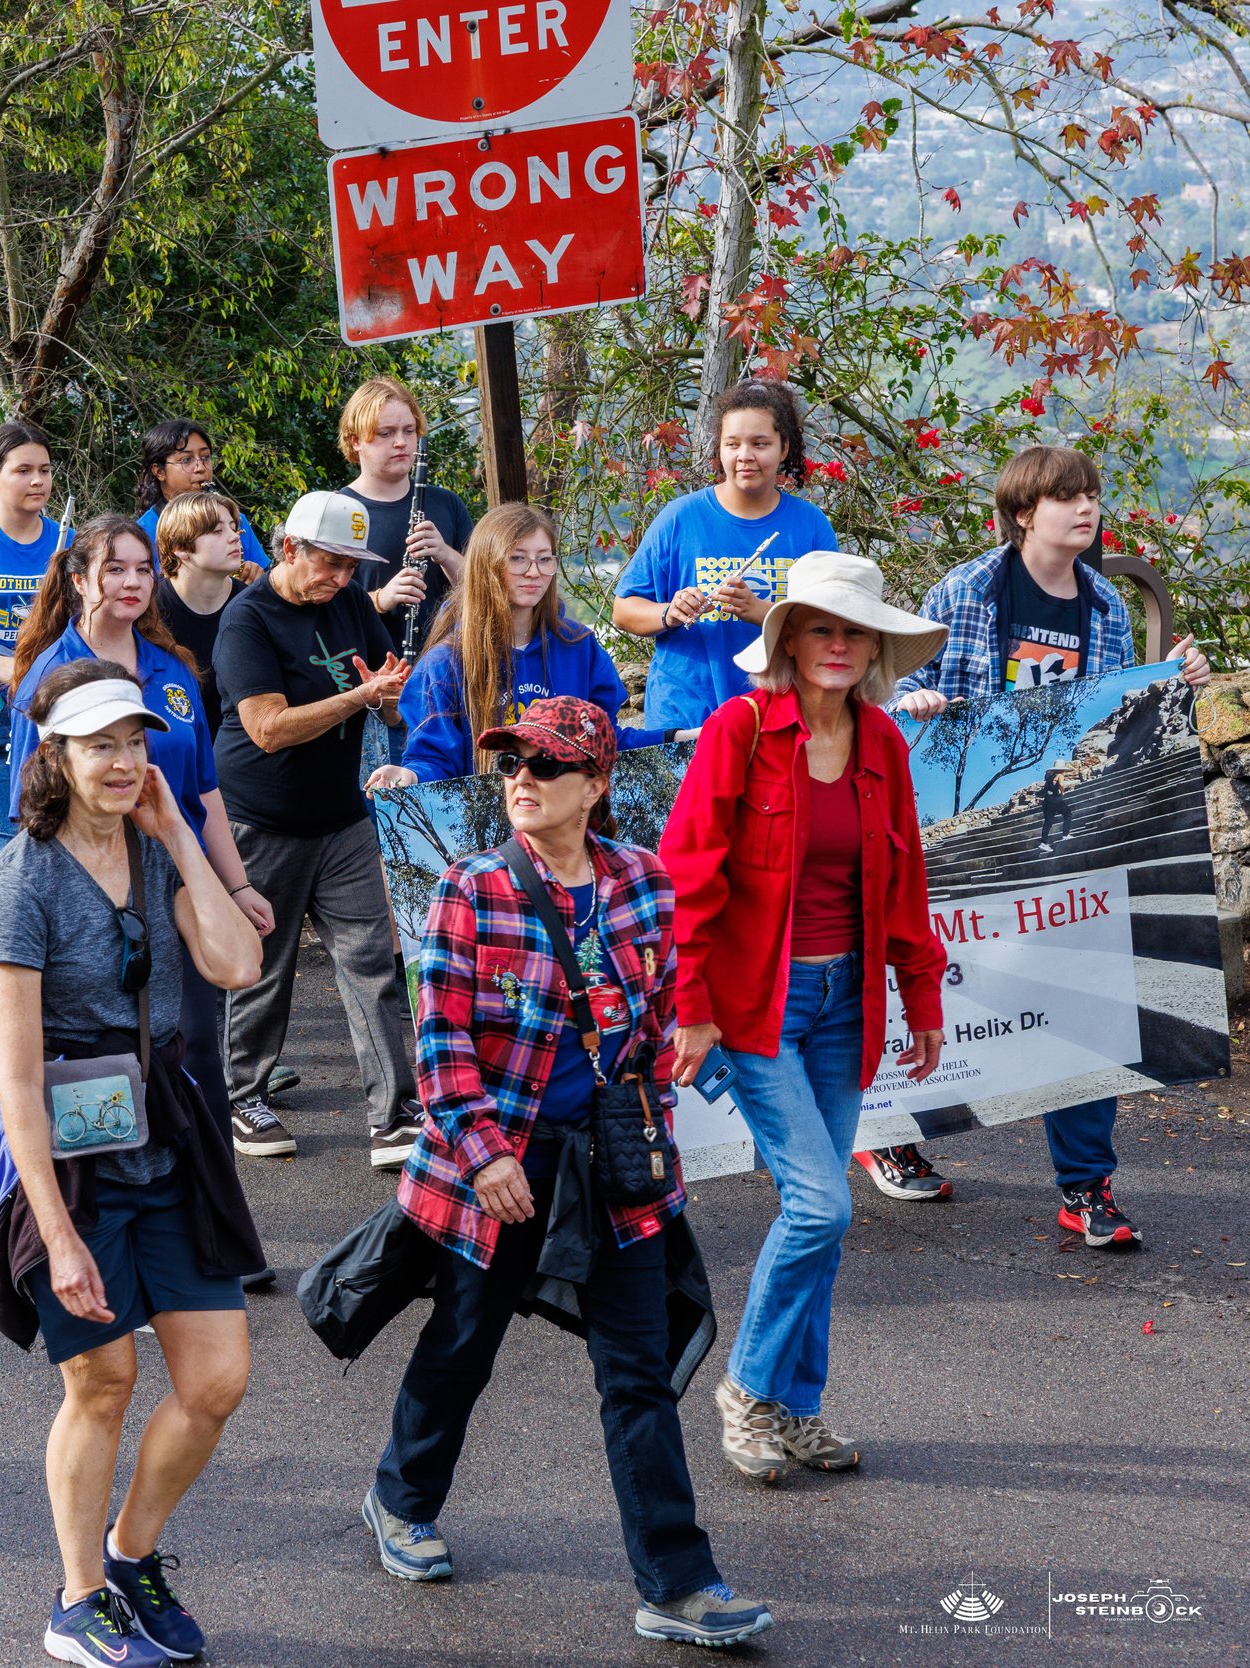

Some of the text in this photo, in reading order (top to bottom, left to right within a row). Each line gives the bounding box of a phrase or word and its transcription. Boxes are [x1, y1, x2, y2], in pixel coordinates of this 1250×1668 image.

[378, 1, 569, 73] ENTER
[347, 145, 626, 231] WRONG
[407, 233, 575, 306] WAY
[933, 886, 1110, 945] Mt. Helix
[955, 1018, 1013, 1044] Helix
[1019, 1010, 1049, 1030] Dr.
[923, 1068, 982, 1086] ASSOCIATION
[942, 1059, 969, 1071] HELIX
